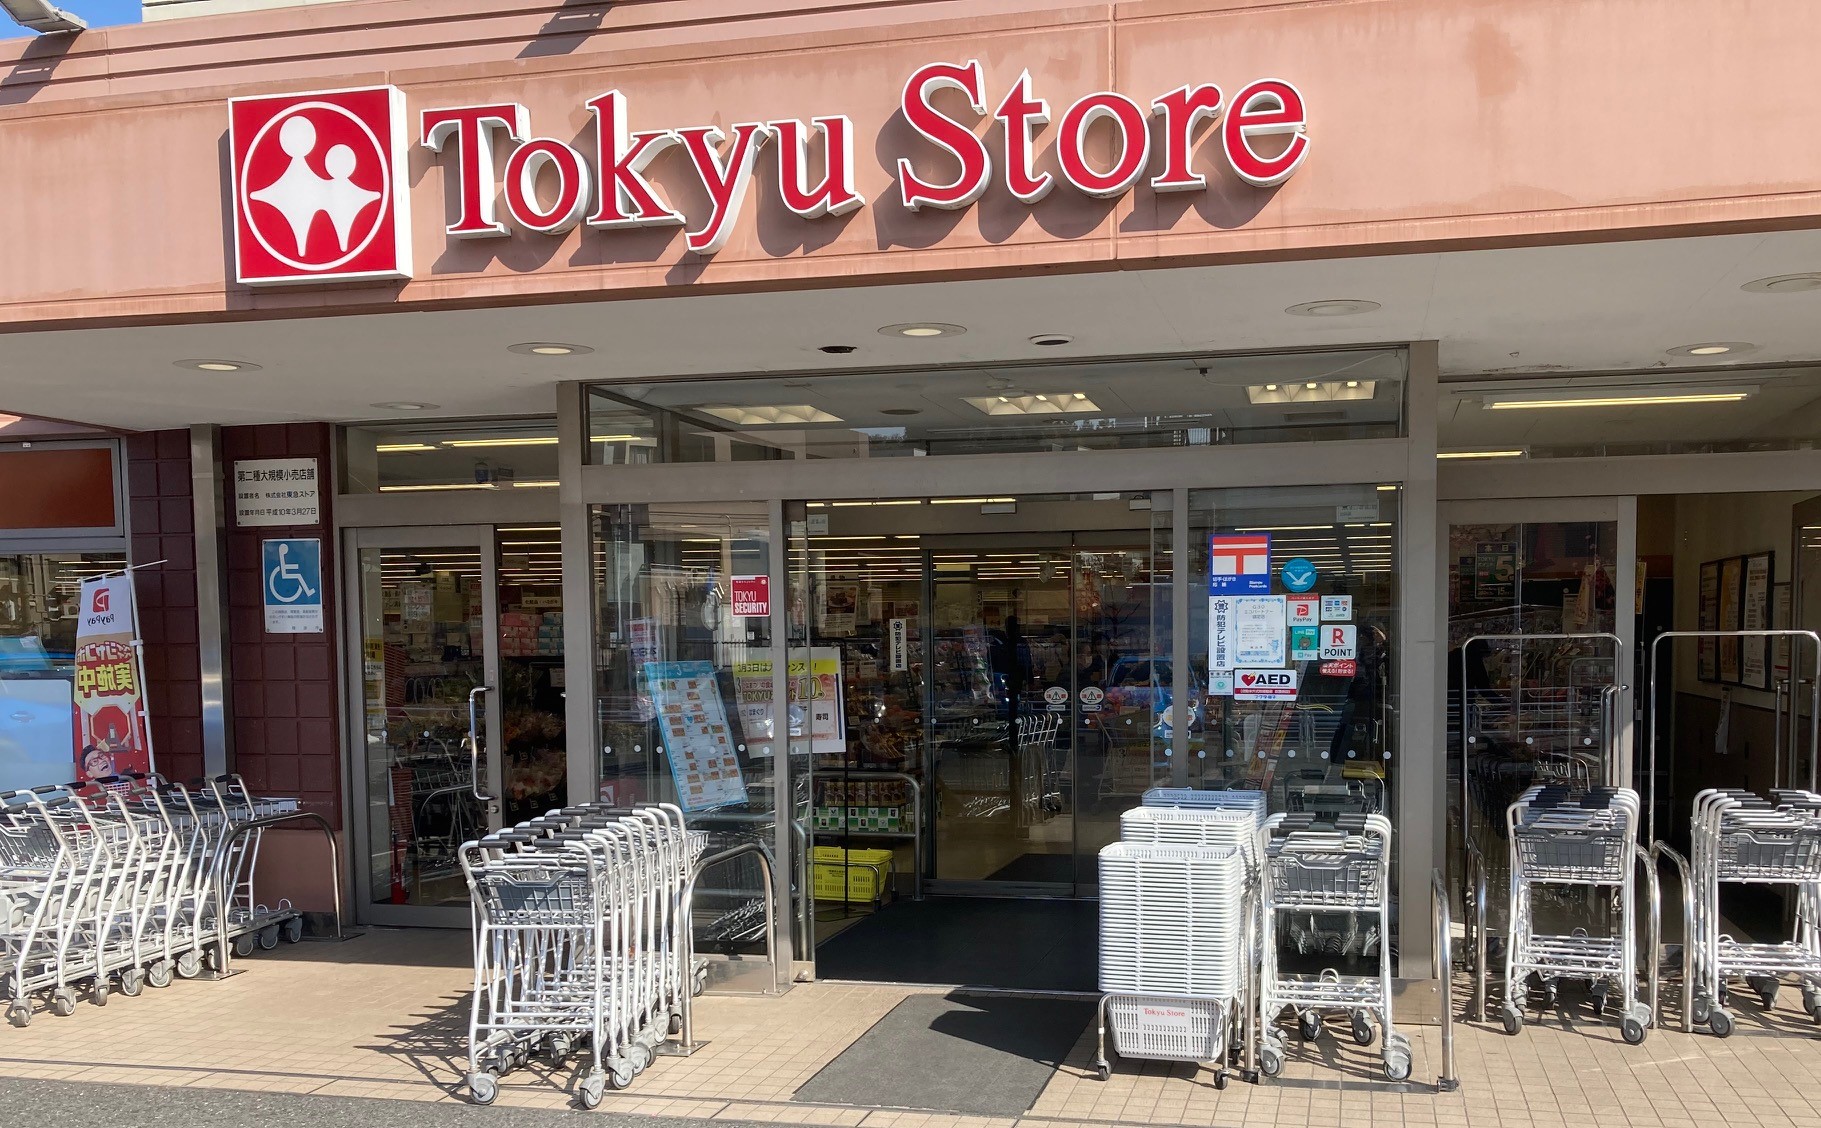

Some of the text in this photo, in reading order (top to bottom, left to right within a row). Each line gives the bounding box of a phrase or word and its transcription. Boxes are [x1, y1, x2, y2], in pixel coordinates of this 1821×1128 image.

[420, 59, 1310, 254] Tokyu Store
[237, 468, 315, 482] 第二種大規模小売店舗
[265, 491, 315, 499] 株式会社東急ストア
[266, 507, 316, 515] 平成10年3月27日
[734, 591, 757, 601] TOKYU
[735, 602, 767, 613] SECURITY
[1216, 615, 1226, 667] 防犯テレビ設置店
[1255, 674, 1290, 684] AED
[1143, 1008, 1185, 1017] Tokyu Store
